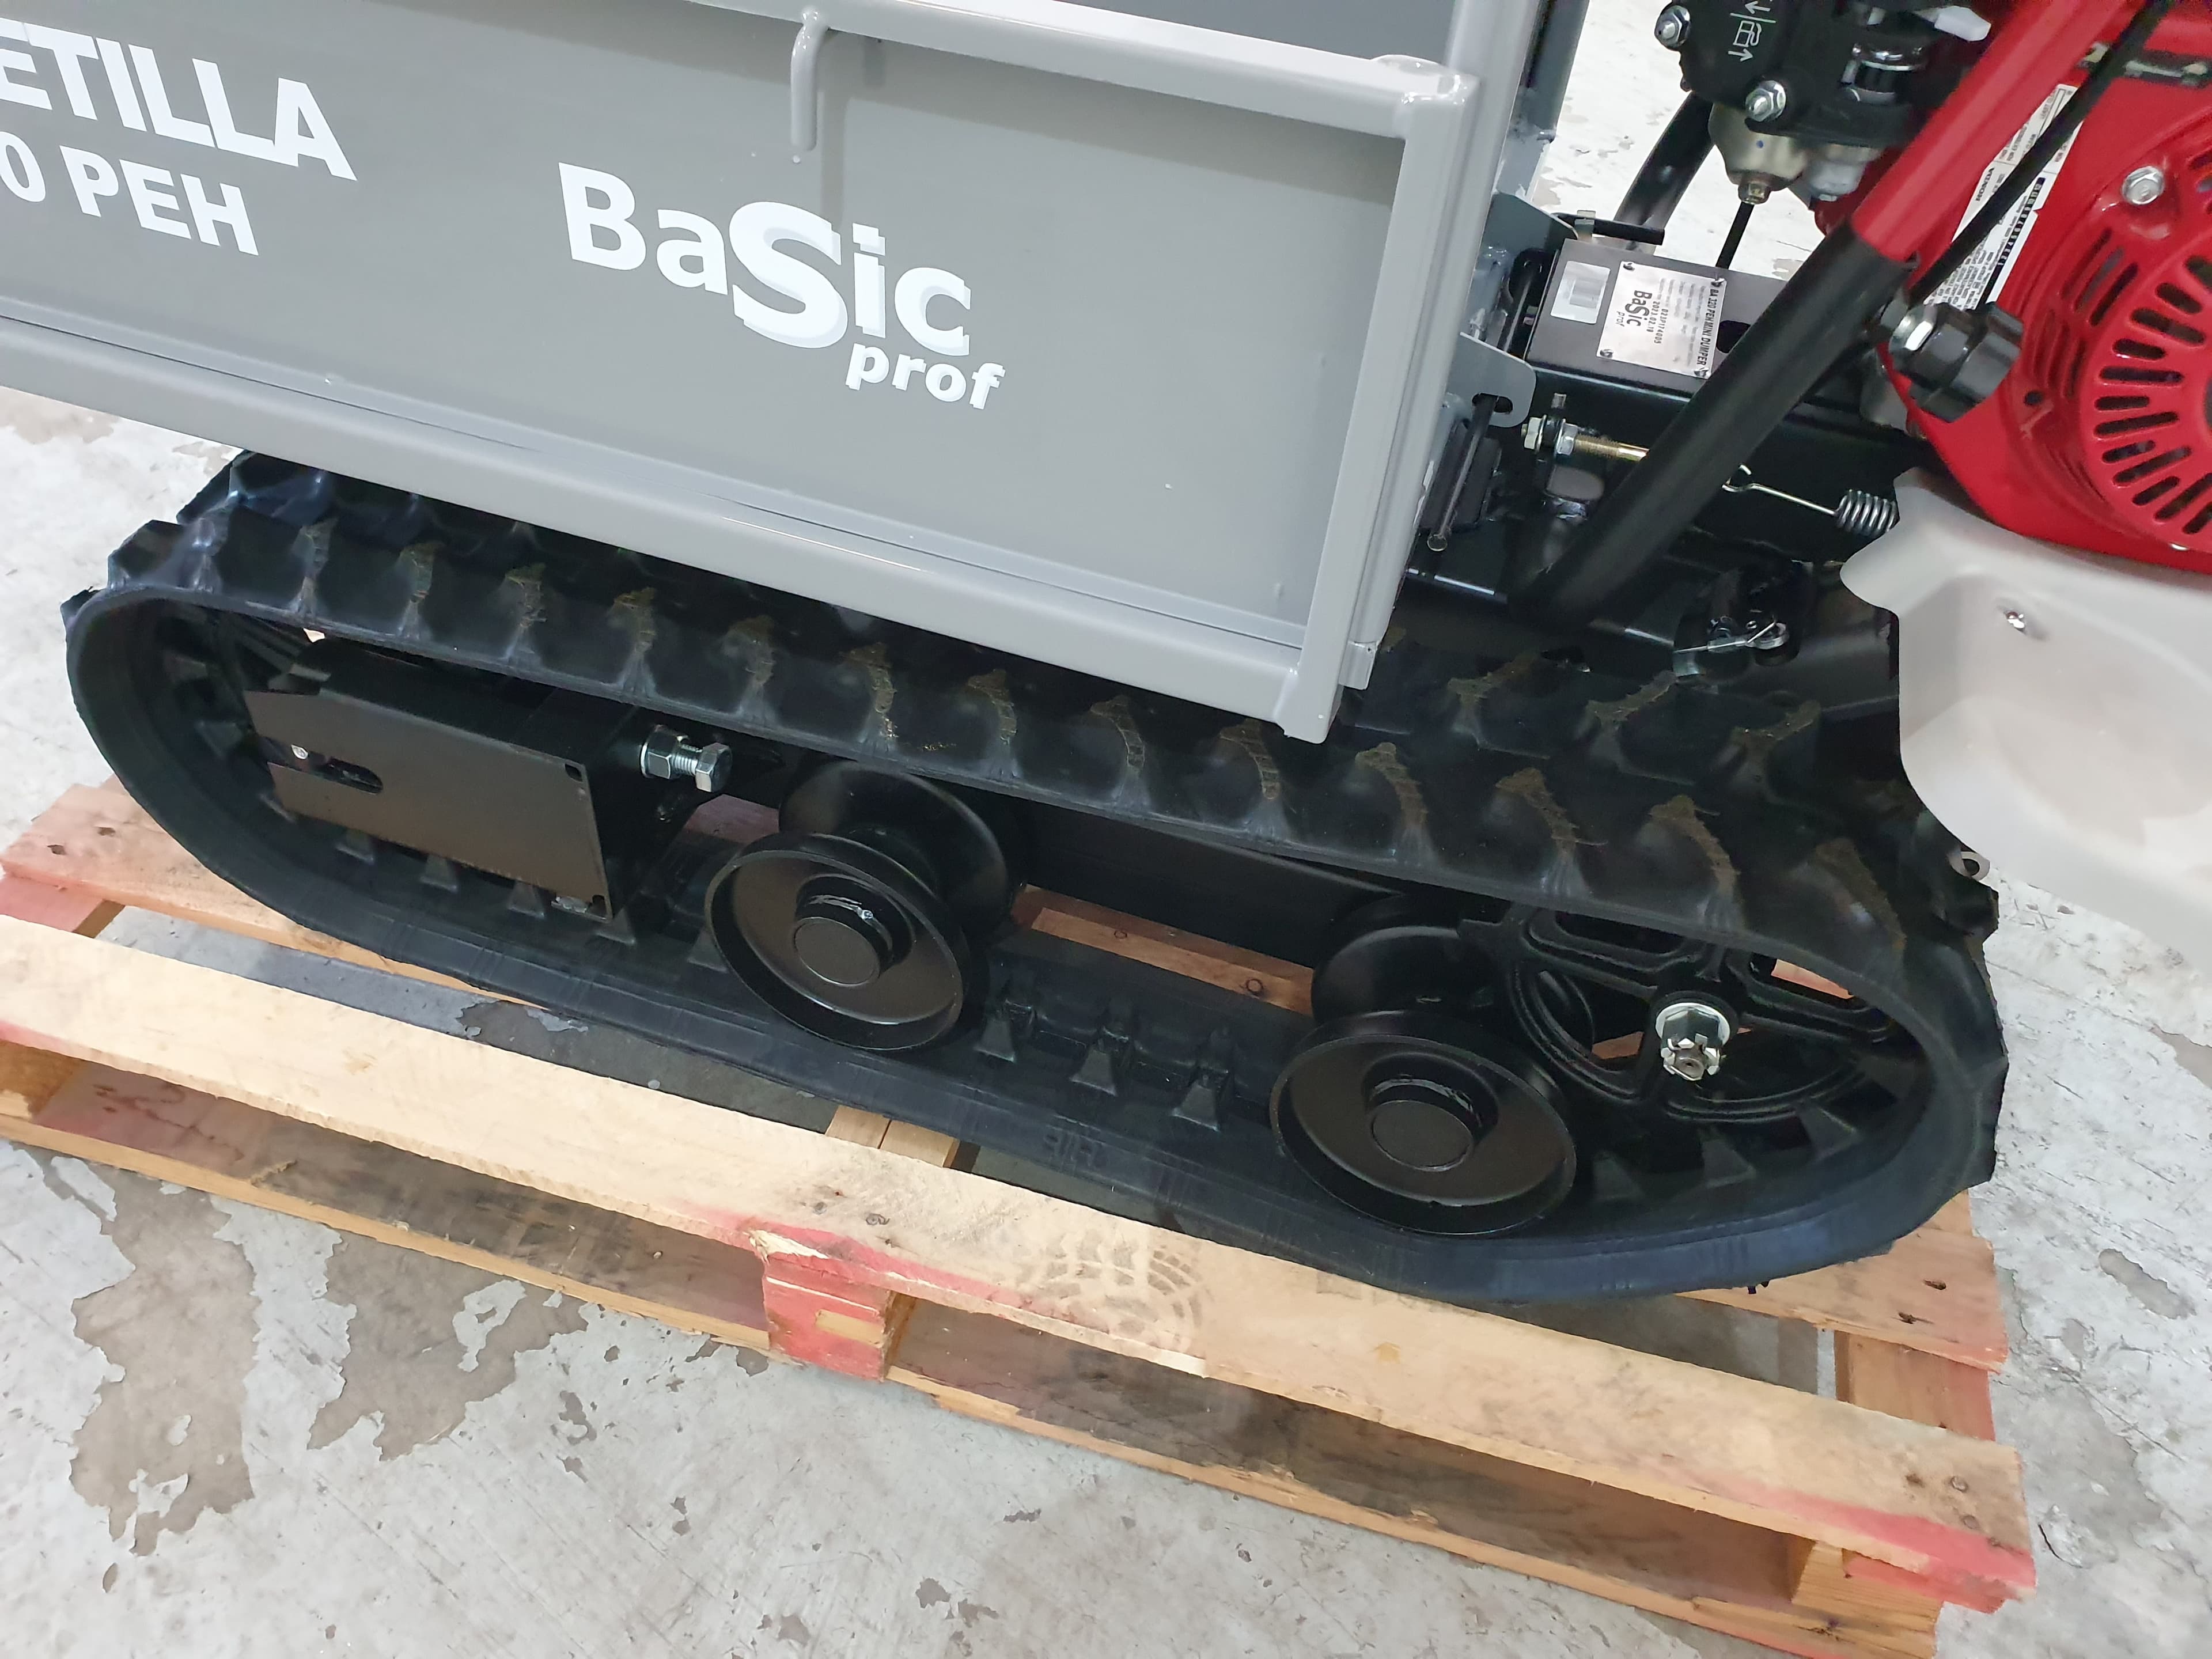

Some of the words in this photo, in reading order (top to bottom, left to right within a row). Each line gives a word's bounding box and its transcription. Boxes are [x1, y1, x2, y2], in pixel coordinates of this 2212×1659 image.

[0, 18, 357, 181] ETILLA
[59, 145, 259, 255] PEH
[1976, 168, 1995, 201] HONDA
[558, 162, 971, 356] BaSic
[1625, 290, 1652, 326] BaSic
[1710, 289, 1719, 297] BA
[1616, 311, 1625, 327] prof
[1702, 321, 1714, 336] MINI
[1696, 337, 1711, 365] DUMPER
[845, 343, 1005, 410] prof
